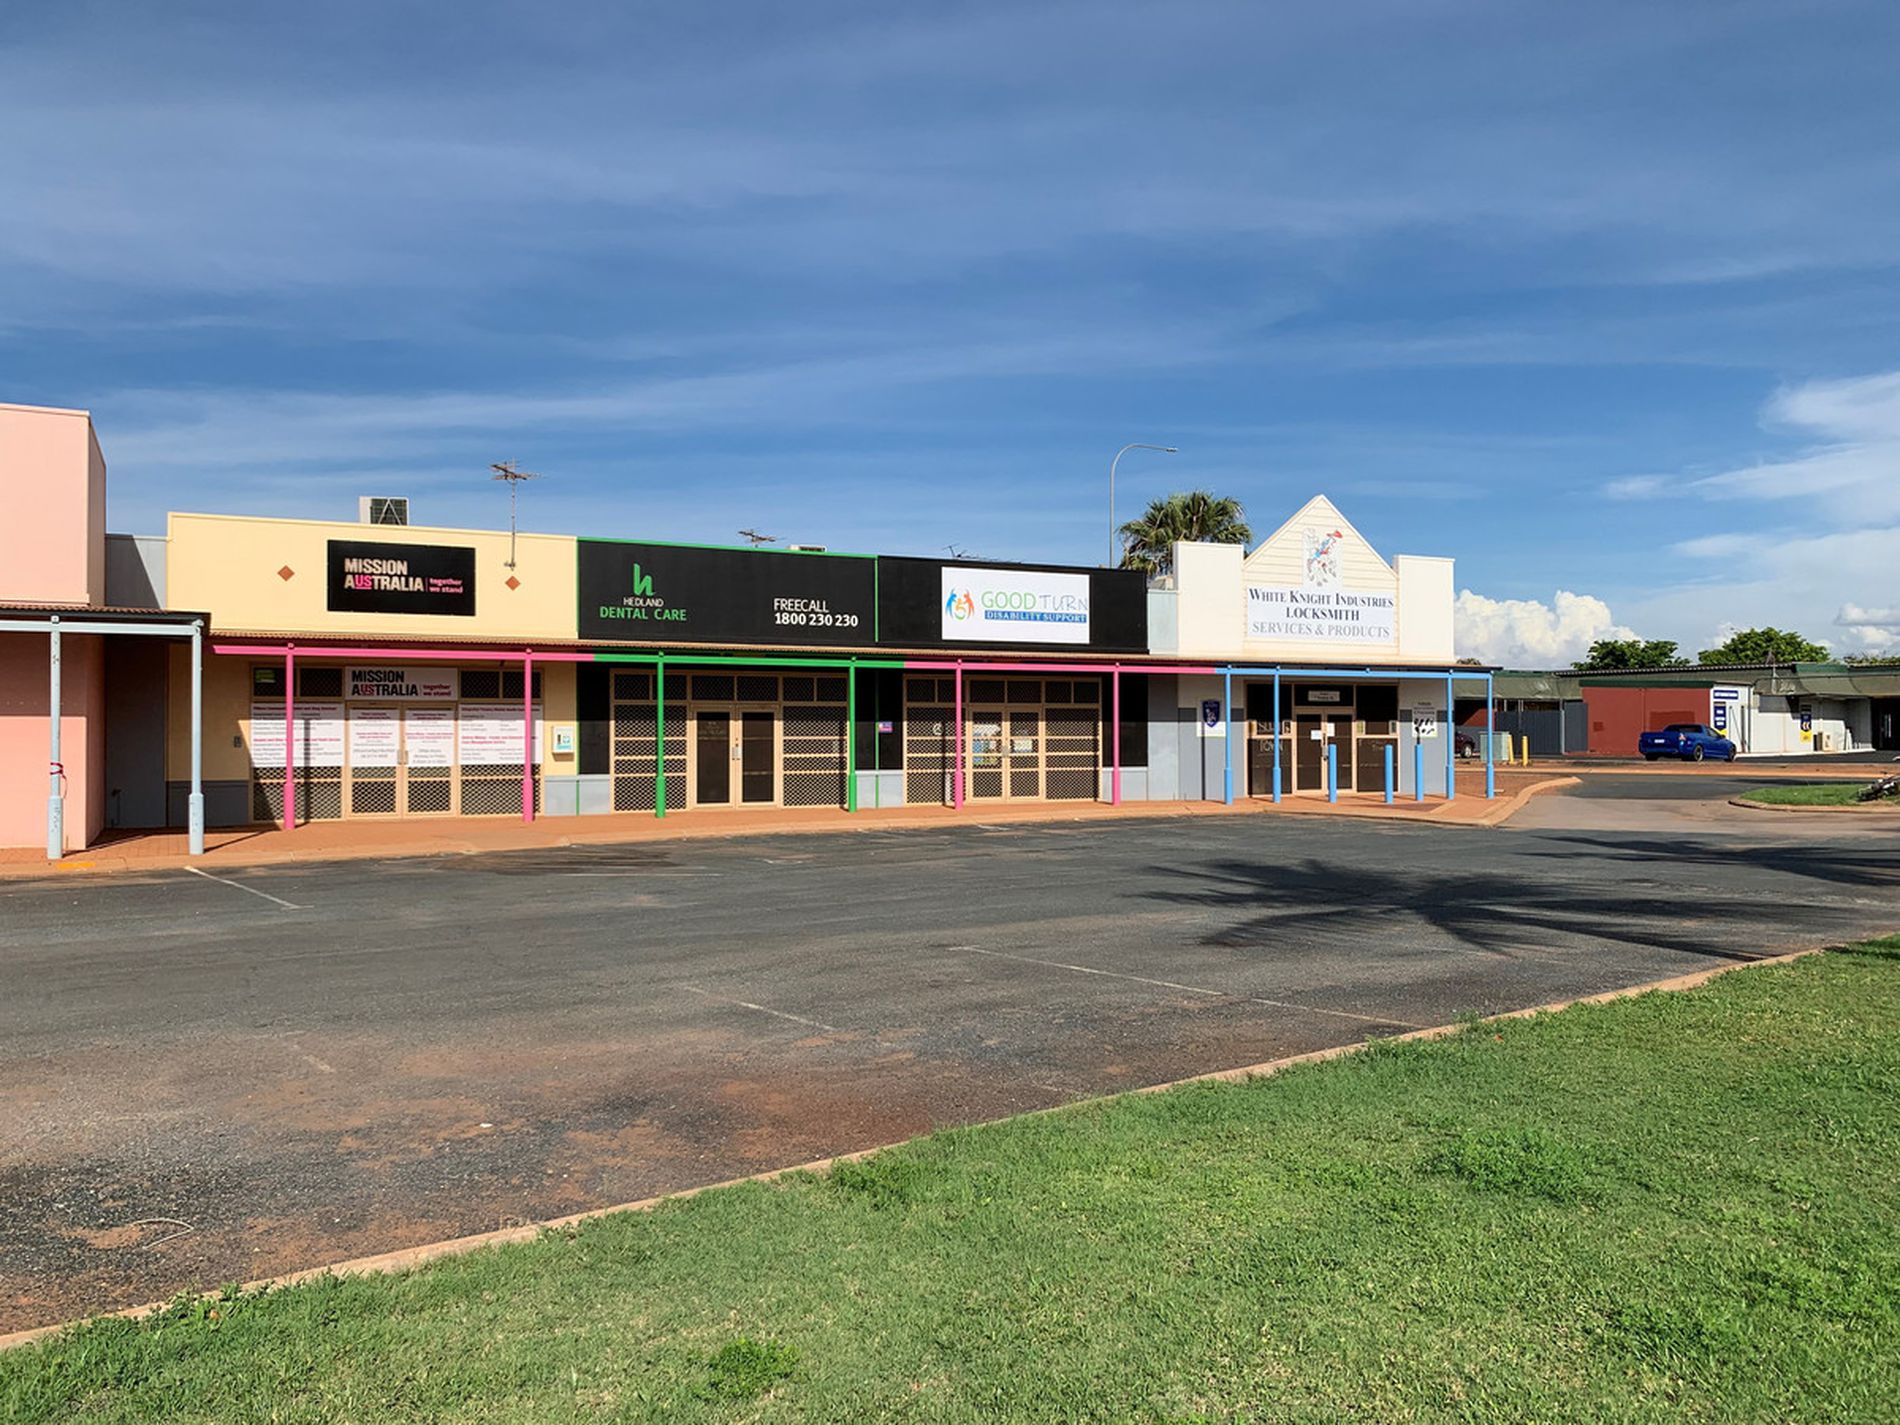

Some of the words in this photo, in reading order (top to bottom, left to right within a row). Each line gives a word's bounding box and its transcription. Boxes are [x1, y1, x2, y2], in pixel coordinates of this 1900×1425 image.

[344, 558, 408, 575] MISSION
[344, 575, 424, 592] AUSTRALIA
[429, 578, 462, 586] together
[623, 597, 665, 607] HEDLAND
[774, 598, 829, 613] FREECALL
[981, 591, 1036, 610] GOOD
[1038, 594, 1089, 612] TURN
[600, 606, 649, 620] DENTAL
[654, 608, 687, 621] CARE
[775, 612, 807, 626] 1800
[808, 613, 833, 627] 230
[835, 614, 859, 627] 230
[986, 610, 1042, 621] DISABILITY
[1043, 612, 1086, 622] SUPPORT
[1286, 607, 1360, 621] LOCKSMITH
[1252, 621, 1312, 636] SERVICES
[1315, 623, 1324, 636] &
[1328, 624, 1390, 638] PRODUCTS
[351, 670, 405, 683] MISSION
[351, 684, 418, 697] AUSTRALIA
